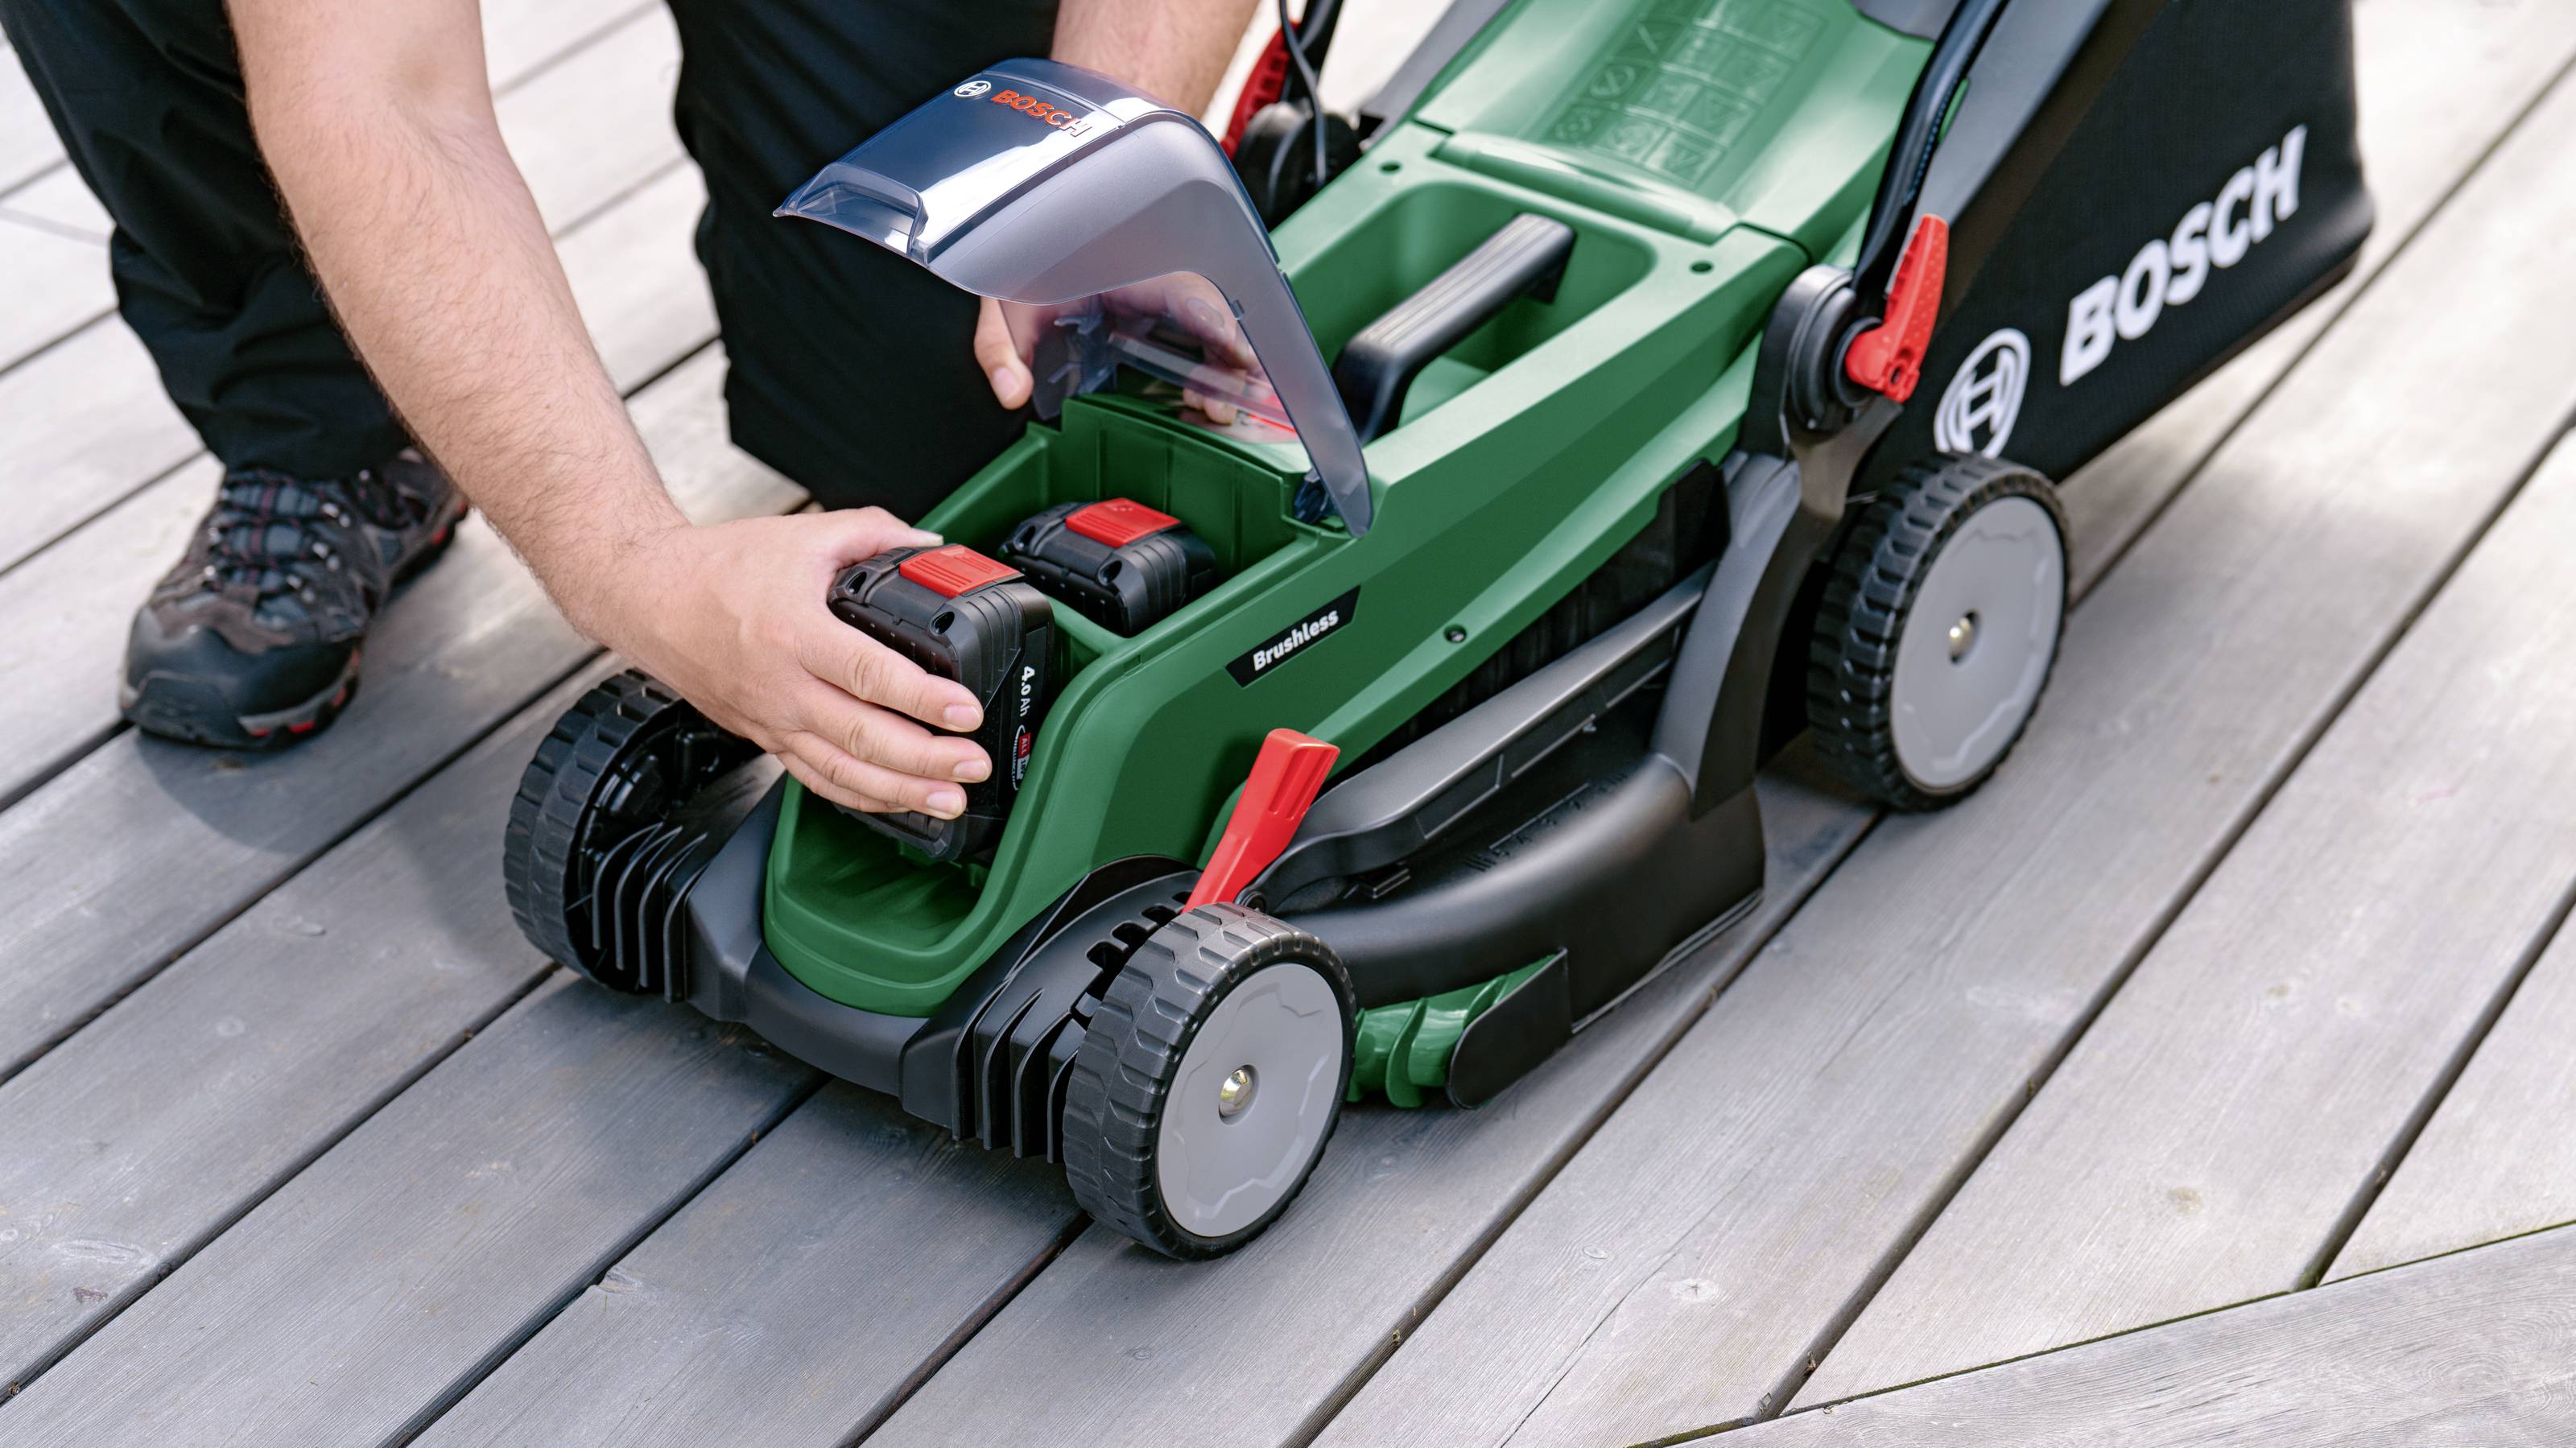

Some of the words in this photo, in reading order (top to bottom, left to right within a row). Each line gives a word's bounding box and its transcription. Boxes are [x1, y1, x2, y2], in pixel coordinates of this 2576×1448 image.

[991, 89, 1092, 137] BOSCH
[2060, 124, 2308, 386] BOSCH
[1253, 610, 1339, 671] Brushless
[1020, 666, 1035, 695] 4.0
[1019, 698, 1030, 716] Ah
